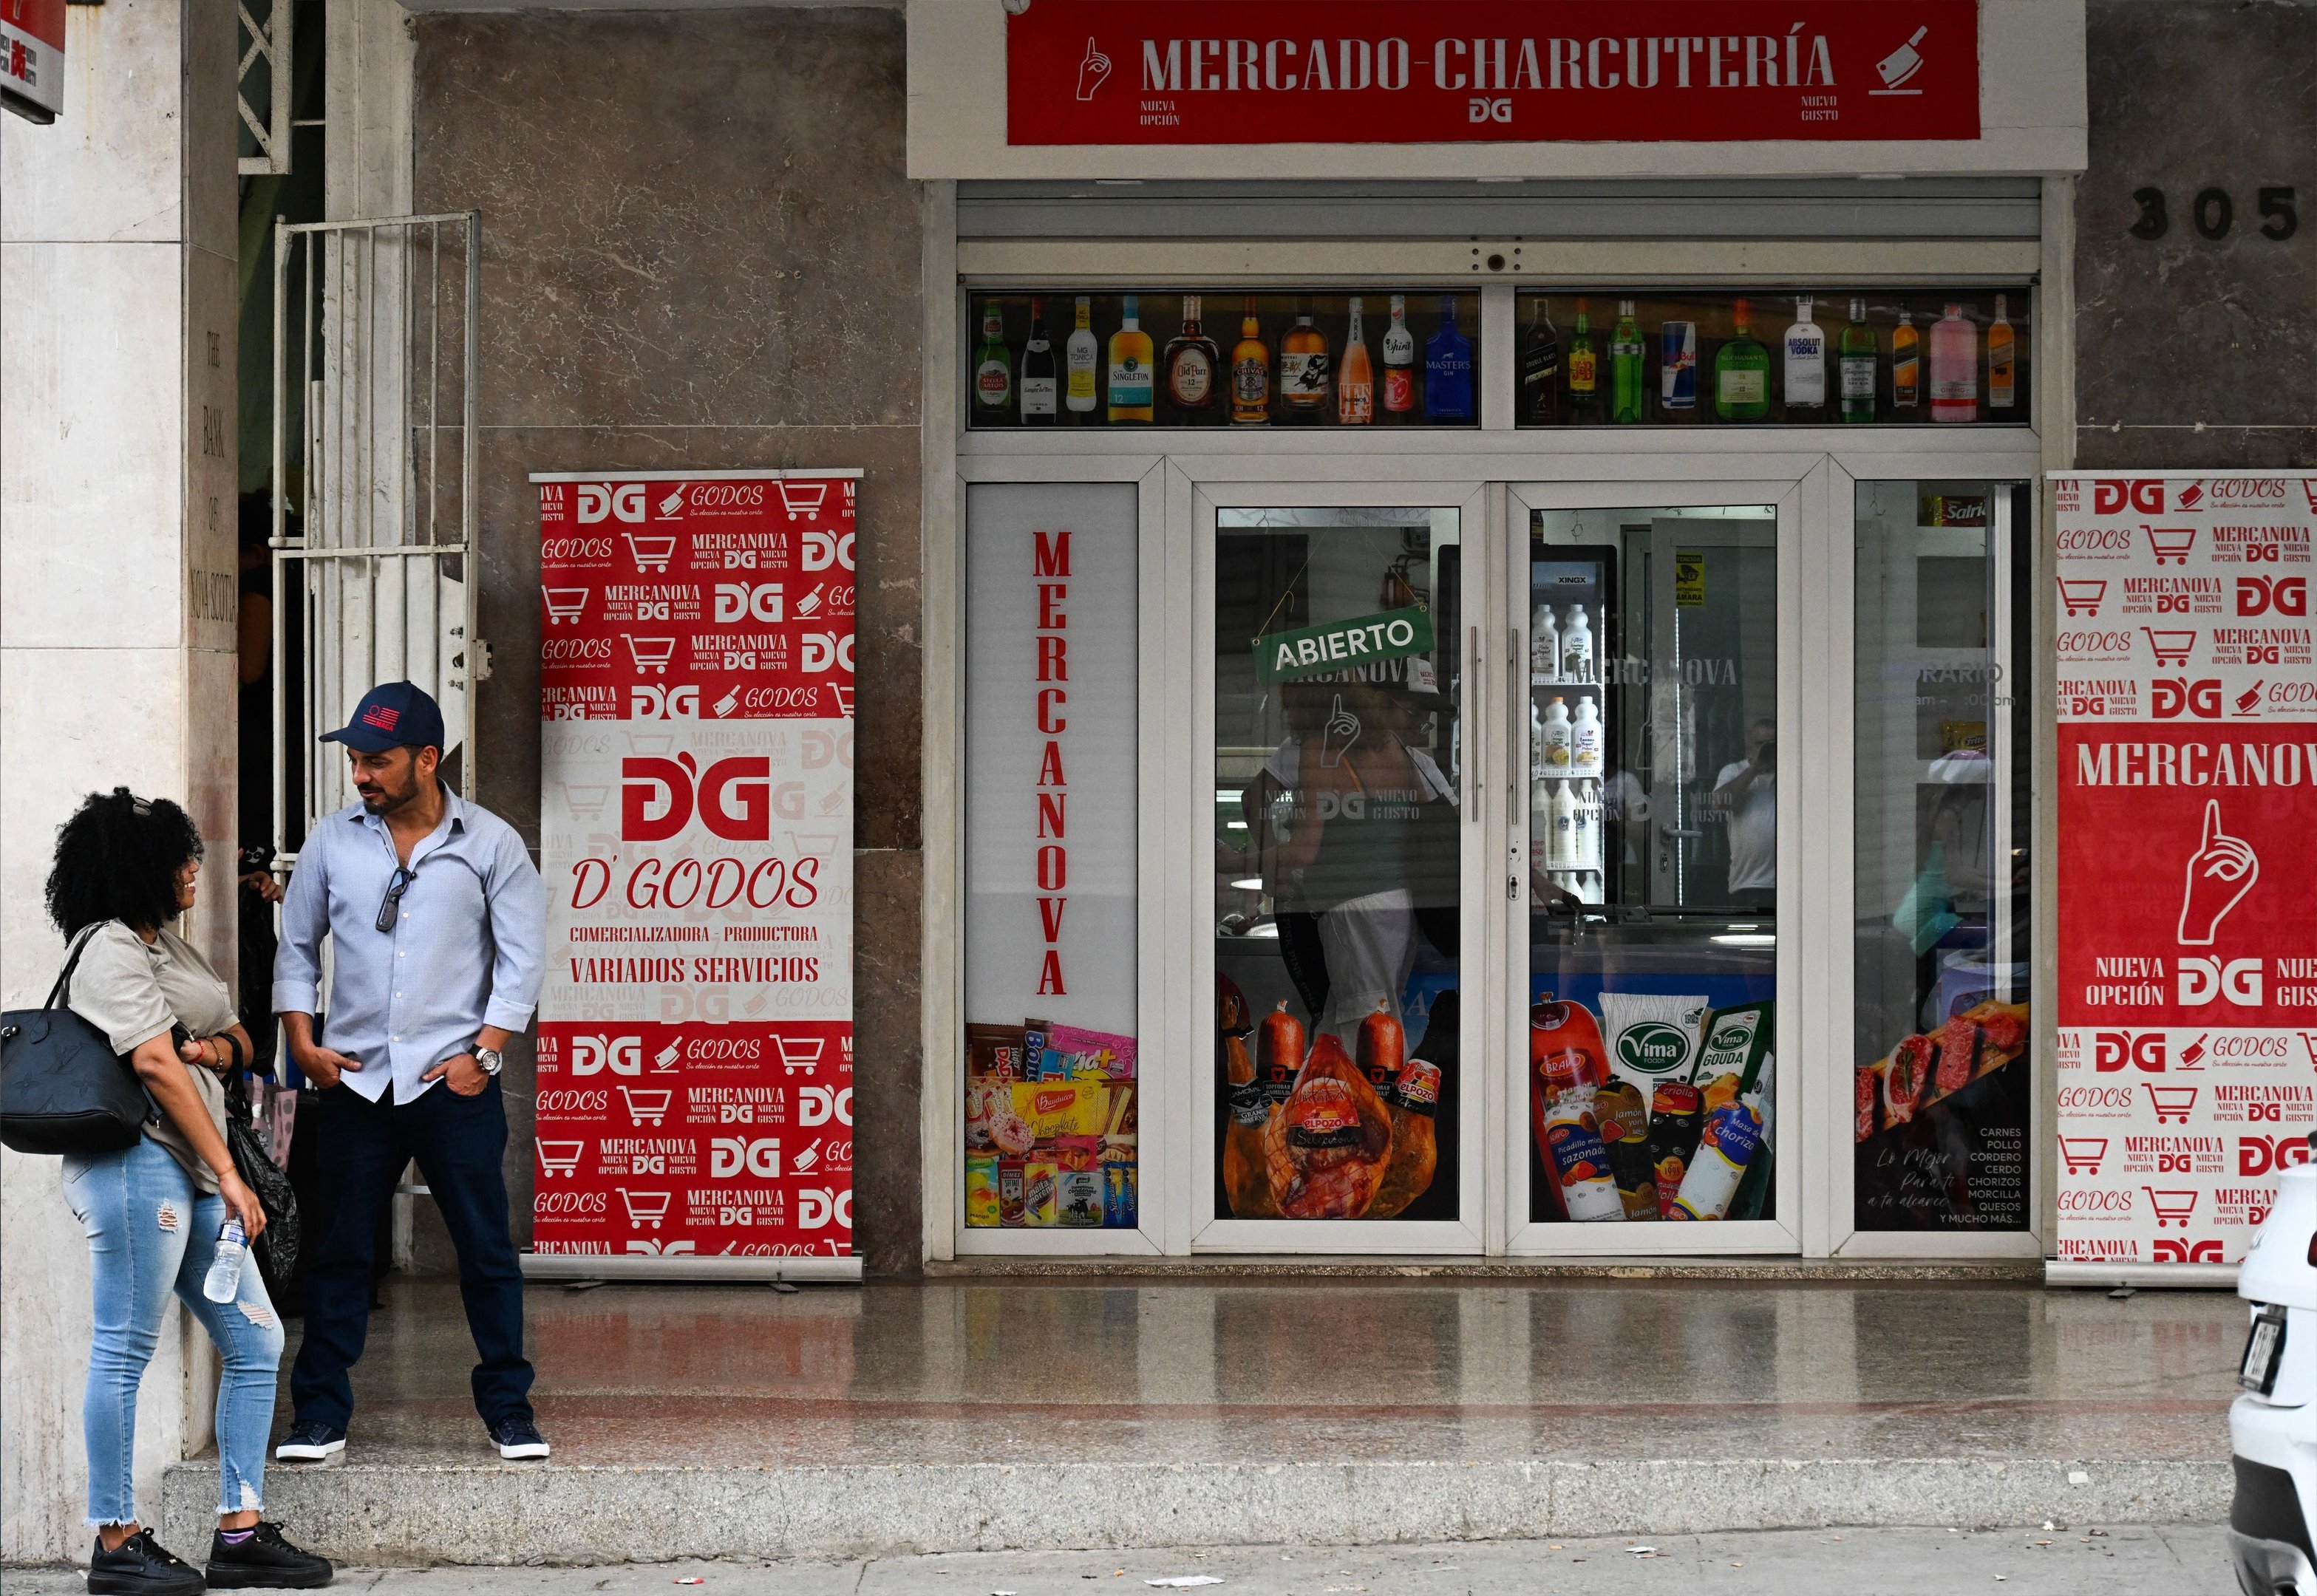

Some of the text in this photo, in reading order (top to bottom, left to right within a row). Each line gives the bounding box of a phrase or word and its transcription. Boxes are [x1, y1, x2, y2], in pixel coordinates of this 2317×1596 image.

[1140, 100, 1175, 112] NUEVA
[1801, 96, 1837, 106] NUEVO
[1140, 113, 1180, 126] OPCIÓN
[1801, 109, 1838, 121] GUSTO
[2129, 187, 2298, 241] 305
[207, 330, 221, 368] THE
[1387, 339, 1411, 354] Spirit
[1789, 338, 1821, 347] ABSOLUT
[1678, 351, 1695, 361] Bull
[1792, 347, 1818, 355] VODKA
[1177, 365, 1207, 377] Old Parr
[1236, 367, 1265, 375] CHIVAS
[1426, 360, 1471, 370] MASTER'S
[1525, 358, 1543, 369] DOUBLE
[1113, 372, 1149, 381] SINGLETON
[1115, 394, 1124, 403] 12
[203, 405, 225, 459] BANK
[691, 485, 763, 505] GODOS
[208, 496, 219, 532] OF
[698, 508, 720, 516] elección
[693, 533, 787, 549] MERCANOVA
[2057, 526, 2310, 550] GODOS MERCANOVA
[542, 538, 612, 558] GODOS
[691, 560, 719, 569] OPCIÓN
[2212, 553, 2310, 562] OPCIÓN GUSTO
[605, 585, 700, 600] MERCANOVA
[2124, 578, 2221, 593] MERCANOVA
[191, 570, 237, 625] NOVA SCOTIA
[692, 635, 786, 649] MERCANOVA
[1276, 619, 1414, 672] ABIERTO
[746, 687, 817, 707] GODOS
[1032, 531, 1072, 995] MERCANOVA
[1372, 806, 1420, 820] GUSTO
[569, 926, 818, 943] COMERCIALIZADORA PRODUCTORA
[569, 956, 820, 983] VARIADOS SERVICIOS
[2096, 957, 2165, 978] NUEVA
[2086, 981, 2164, 1006] OPCIÓN
[687, 1040, 760, 1059] GODOS
[1622, 1028, 1677, 1057] Vima
[2214, 1037, 2287, 1057] GODOS
[1703, 1051, 1743, 1066] GOUDA
[536, 1088, 784, 1110] GODOS MERCANOVA
[1663, 1086, 1694, 1098] criolla
[2216, 1086, 2313, 1101] MERCANOVA
[1037, 1093, 1074, 1112] Bauducco
[1241, 1109, 1262, 1118] GRAN
[1614, 1108, 1642, 1121] Jamón
[1031, 1113, 1080, 1137] Chocolate
[1628, 1118, 1644, 1128] york
[1730, 1117, 1752, 1133] Masa
[1715, 1125, 1755, 1151] chorizo
[1980, 1128, 2021, 1137] CARNES
[600, 1139, 696, 1153] MERCANOVA
[1557, 1139, 1586, 1155] Picadillo
[1987, 1140, 2021, 1150] POLLO
[2126, 1137, 2222, 1152] MERCANOVA
[1562, 1145, 1606, 1166] sazonado
[1970, 1153, 2021, 1162] CORDERO
[1664, 1167, 1680, 1176] 1995
[1985, 1165, 2021, 1175] CERDO
[1028, 1180, 1049, 1198] malta
[1967, 1177, 2021, 1187] CHORIZOS
[1027, 1184, 1055, 1206] morena
[1968, 1190, 2021, 1199] MORCILLA
[1979, 1202, 2021, 1212] QUESOS
[1940, 1215, 1947, 1223] Y
[1949, 1215, 1988, 1224] MUCHO
